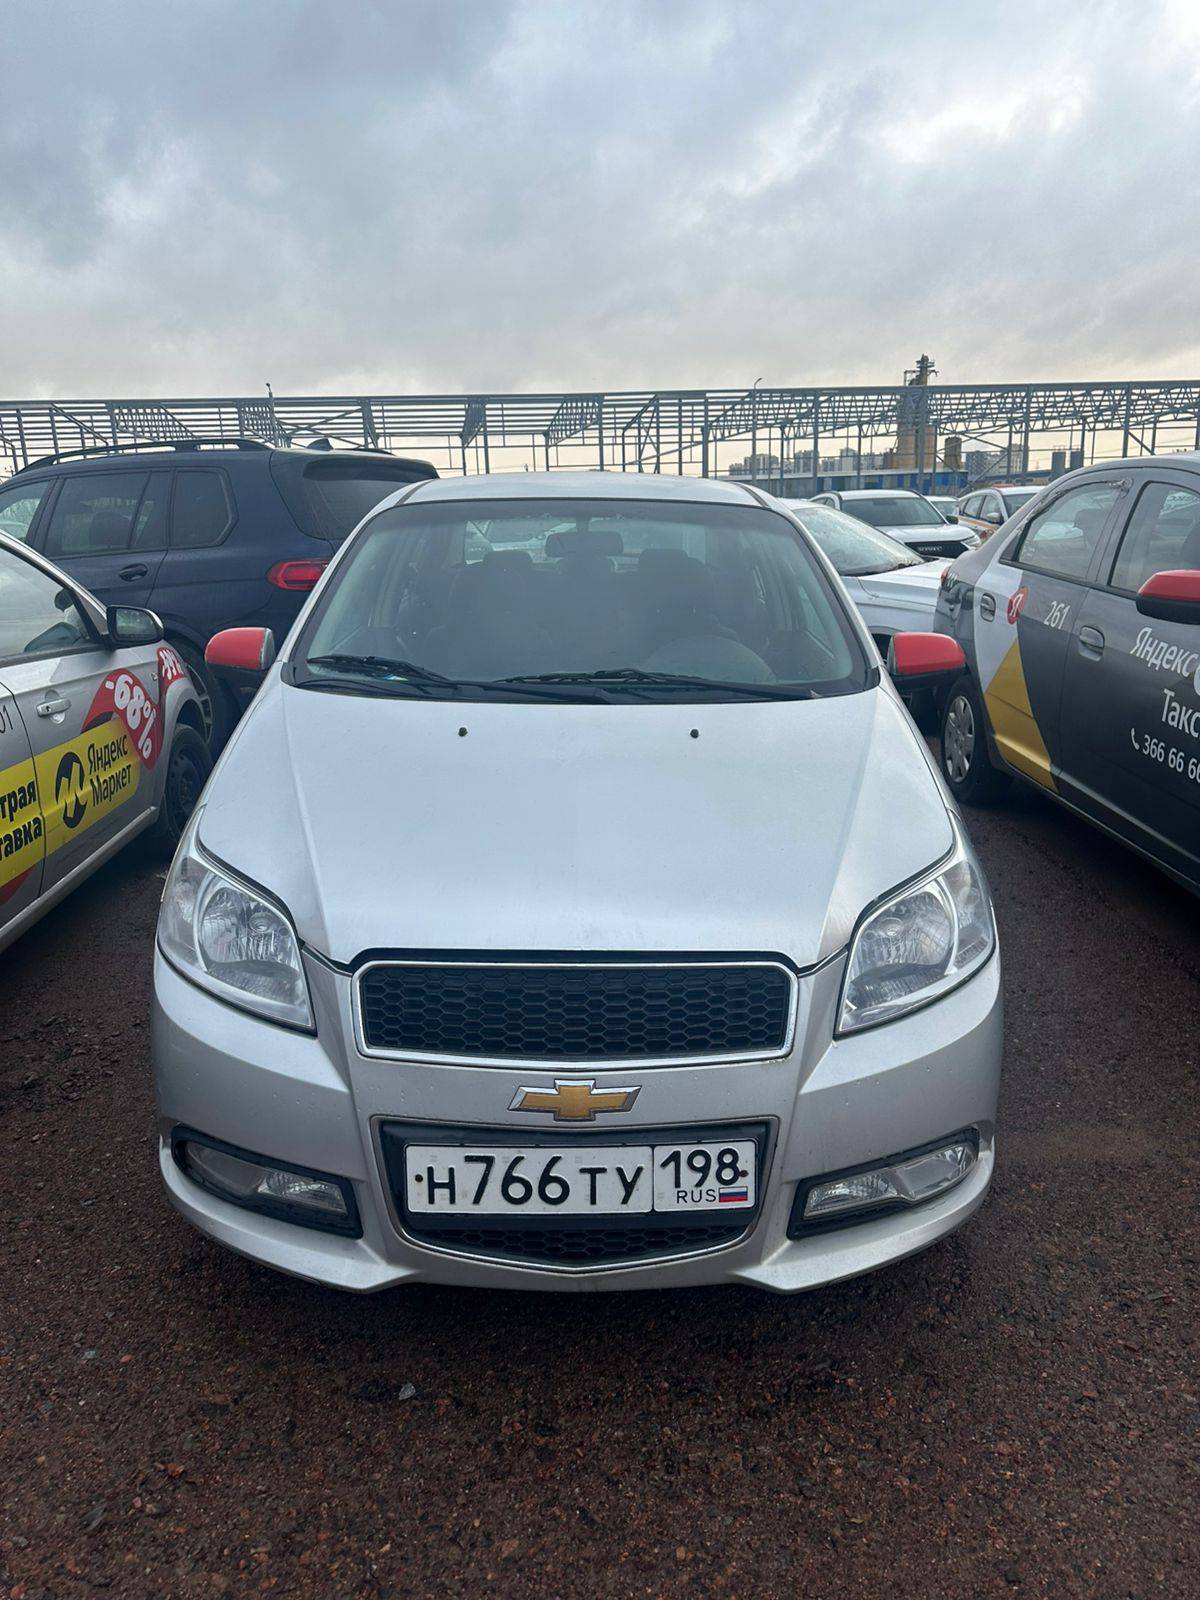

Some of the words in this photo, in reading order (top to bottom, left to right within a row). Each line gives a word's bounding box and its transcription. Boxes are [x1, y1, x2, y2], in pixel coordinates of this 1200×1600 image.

[1043, 600, 1071, 630] 261
[1130, 626, 1199, 678] Яндекс
[105, 673, 157, 760] -68%
[87, 735, 129, 775] Яндекс
[1142, 734, 1166, 763] 366
[1168, 748, 1185, 773] 66
[90, 764, 132, 807] Маркет
[660, 1147, 741, 1189] 198
[676, 1188, 717, 1205] RUS
